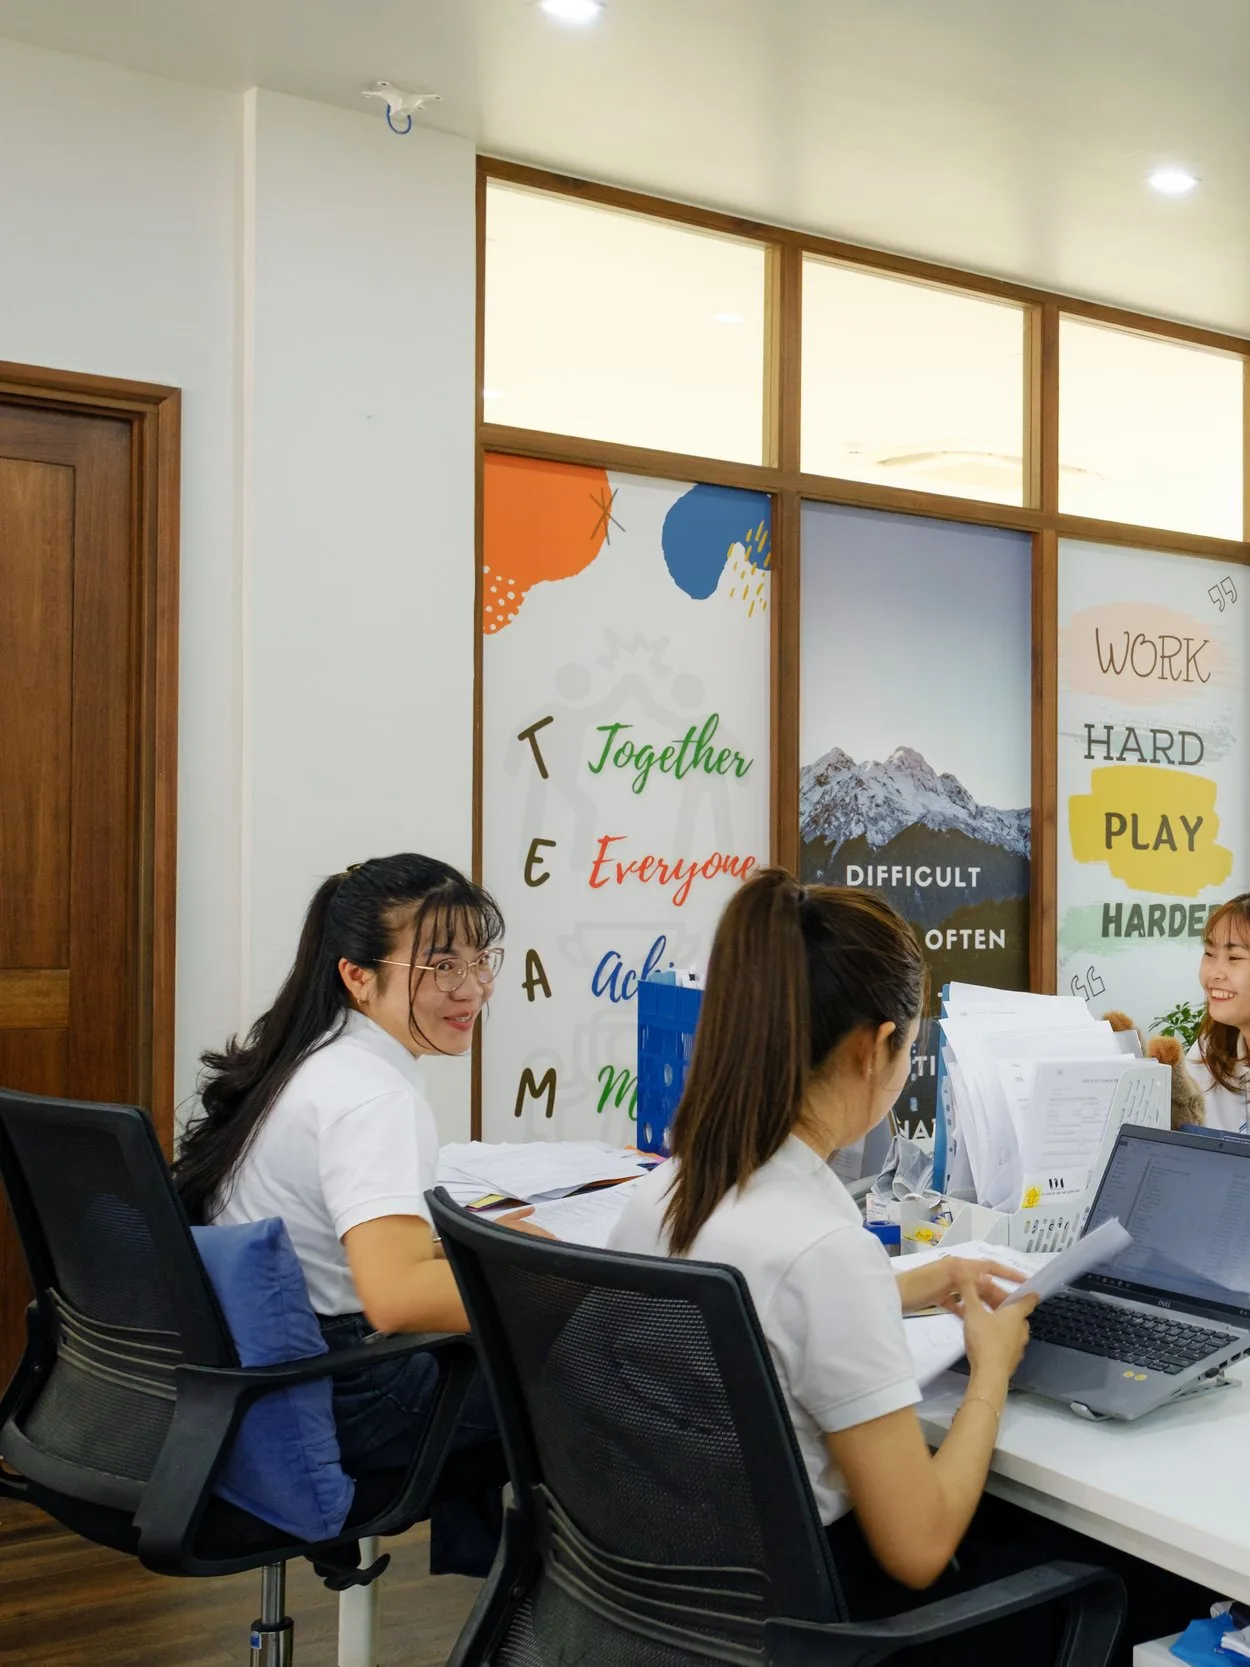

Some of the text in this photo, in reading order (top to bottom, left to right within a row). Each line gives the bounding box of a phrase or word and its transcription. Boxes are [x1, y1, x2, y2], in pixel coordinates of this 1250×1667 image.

[1095, 627, 1211, 683] WORK
[517, 713, 754, 794] T Together
[1084, 723, 1204, 766] HARD
[1105, 812, 1204, 851] PLAY
[524, 835, 756, 906] E Everyone
[846, 865, 981, 887] DIFFICULT
[925, 929, 1006, 950] OFTEN
[1101, 902, 1222, 938] HARDE
[522, 949, 552, 1002] A
[514, 1067, 557, 1118] M
